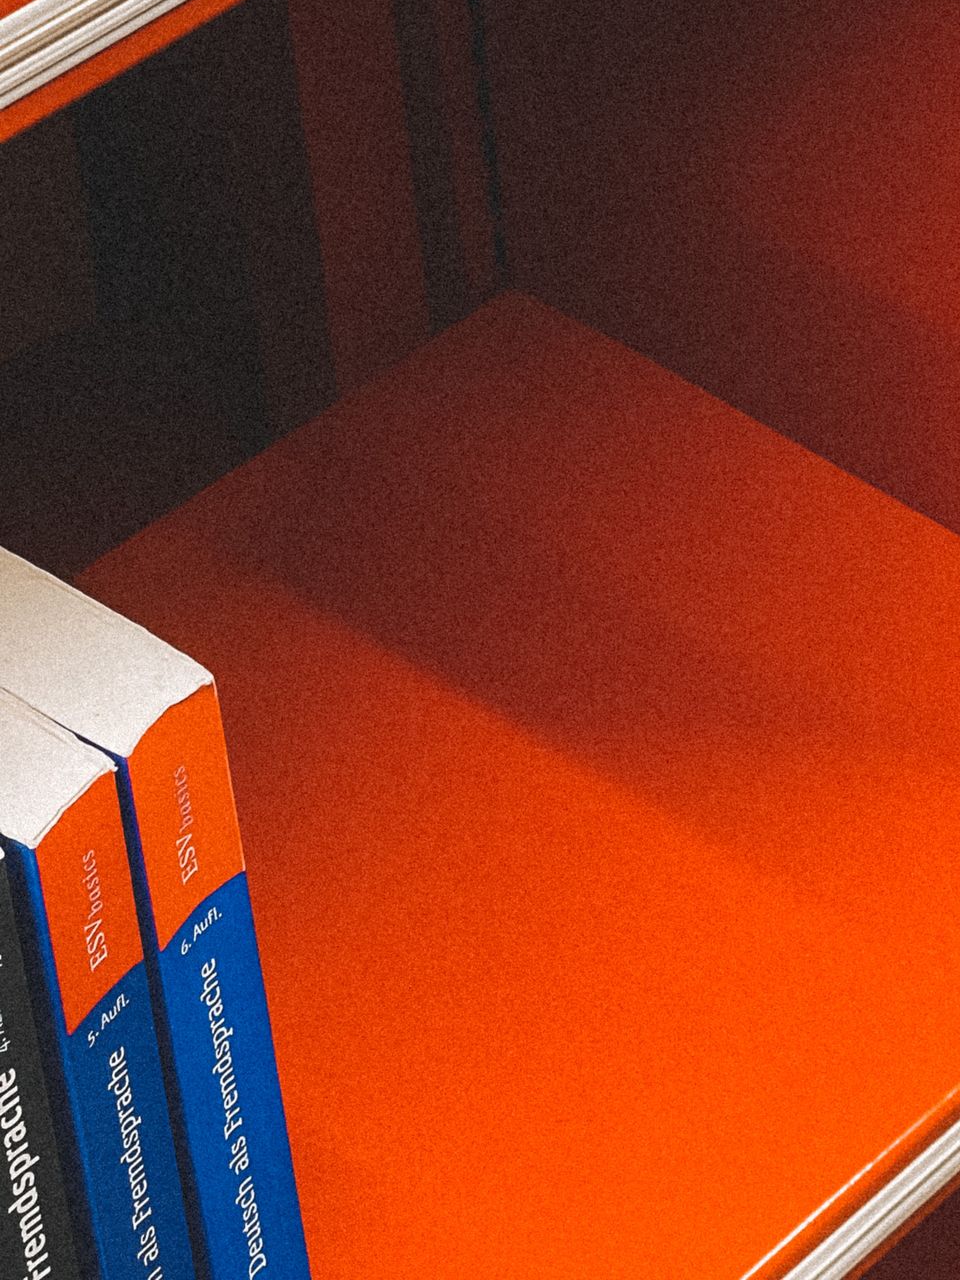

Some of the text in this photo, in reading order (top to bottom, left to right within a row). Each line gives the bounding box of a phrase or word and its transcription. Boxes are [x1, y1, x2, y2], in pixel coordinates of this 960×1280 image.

[175, 834, 198, 885] ESV
[84, 919, 108, 972] ESV
[181, 906, 222, 956] 6. Aufl.
[87, 993, 130, 1049] 5. Aufl.
[108, 1046, 152, 1231] Fremdsprache
[201, 958, 267, 1280] Deutsch als Fremdsprache
[137, 1225, 159, 1267] als
